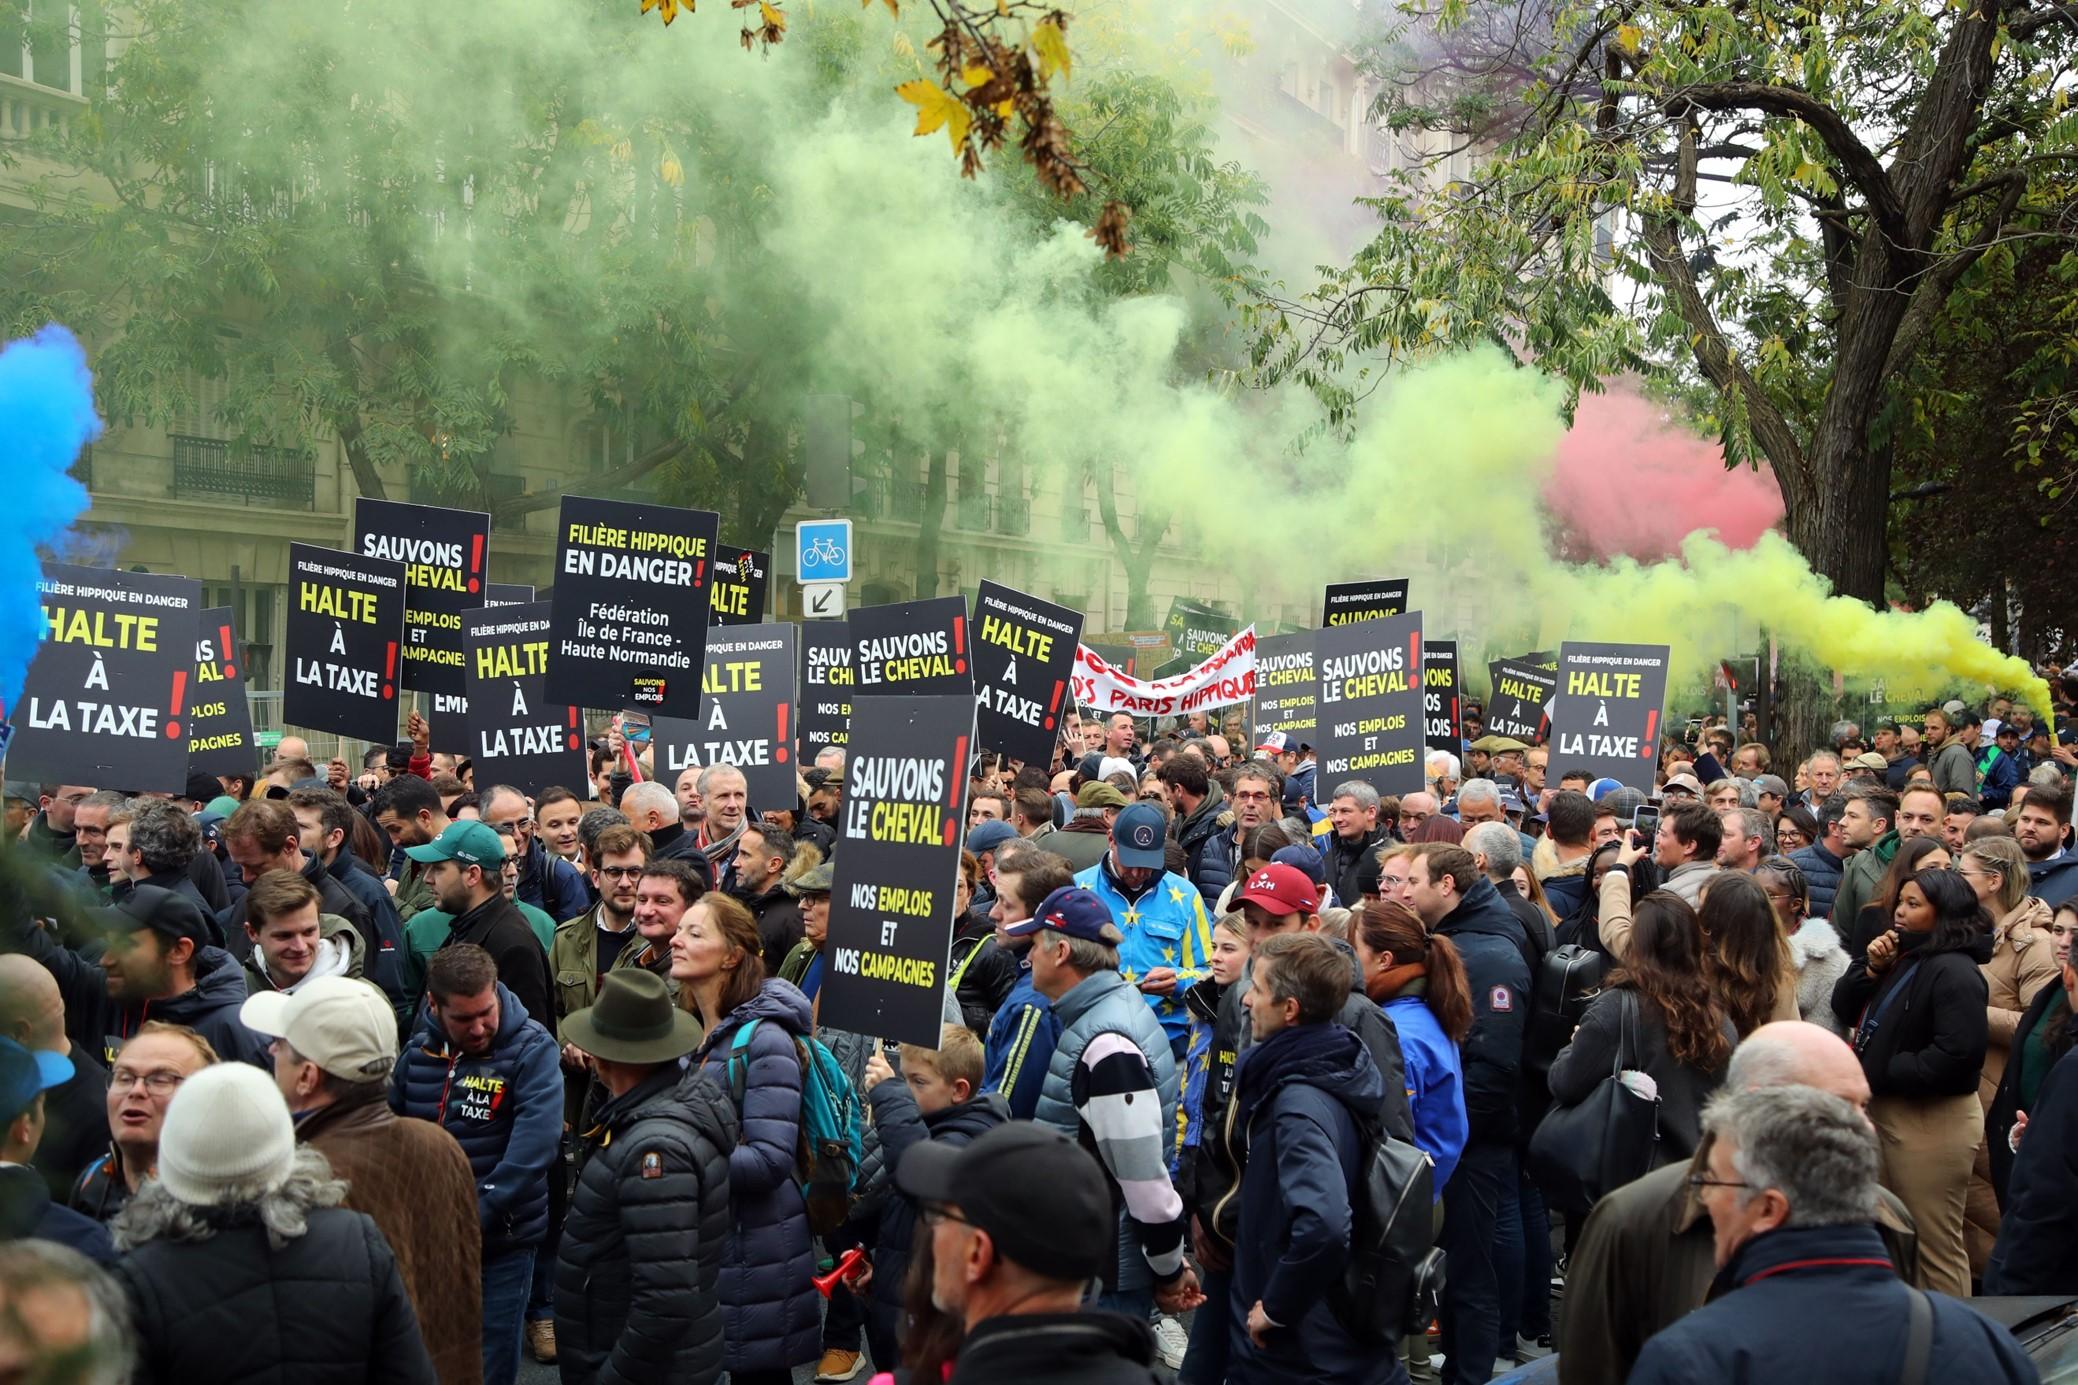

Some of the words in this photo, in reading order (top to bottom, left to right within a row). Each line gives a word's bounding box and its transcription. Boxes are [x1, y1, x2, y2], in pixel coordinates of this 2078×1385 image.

[364, 533, 462, 568] SAUVONS
[569, 522, 627, 548] FILIÈRE
[631, 531, 706, 558] HIPPIQUE
[298, 560, 322, 576] FILIÈRE
[324, 564, 356, 582] HIPPIQUE
[357, 570, 367, 582] EN
[368, 572, 396, 588] DANGER
[564, 549, 594, 575] EN
[406, 564, 466, 592] HEVAL
[36, 580, 75, 596] FILIÈRE
[76, 585, 126, 604] HIPPIQUE
[128, 591, 144, 604] EN
[145, 593, 188, 610] DANGER
[300, 582, 376, 624] HALTE
[710, 581, 749, 616] ALTE
[1350, 594, 1373, 602] HIPPIQUE
[405, 610, 462, 630] EMPLOIS
[590, 602, 669, 626] Fédération
[985, 596, 1007, 614] FILIÈRE
[1007, 602, 1036, 622] HIPPIQUE
[1037, 614, 1047, 625] EN
[1048, 618, 1073, 635] DANGER
[38, 606, 158, 652] HALTE
[330, 622, 346, 655] À
[411, 628, 427, 643] ET
[470, 624, 495, 637] FILIÈRE
[496, 622, 529, 635] HIPPIQUE
[530, 622, 540, 630] EN
[578, 618, 596, 638] Île
[600, 623, 618, 641] de
[622, 626, 672, 647] France
[981, 616, 1053, 663] HALTE
[1187, 628, 1228, 645] SAUVONS
[402, 646, 466, 667] AMPAGNE
[561, 640, 605, 660] Haute
[610, 645, 690, 669] Normandie
[706, 642, 733, 654] PIQUE
[735, 643, 748, 651] EN
[748, 640, 783, 650] DANGER
[808, 647, 850, 666] SAUV
[858, 630, 947, 662] SAUVONS
[1186, 640, 1196, 652] LE
[84, 650, 109, 690] À
[861, 662, 882, 684] LE
[885, 655, 954, 682] CHEVAL
[1002, 655, 1016, 685] À
[1322, 647, 1402, 681] SAUVONS
[1568, 654, 1591, 664] FILIÈRE
[1592, 656, 1622, 666] HIPPIQUE
[1633, 658, 1661, 667] DANGER
[296, 657, 321, 686] LA
[326, 662, 378, 698] TAXE
[634, 677, 666, 686] SAUVONS
[808, 667, 825, 684] LE
[1269, 666, 1316, 686] CHEVAL
[1323, 681, 1341, 703] LE
[1344, 670, 1408, 699] CHEVAL
[1567, 672, 1641, 698] HALTE
[512, 680, 528, 716] À
[635, 694, 663, 702] EMPLOIS
[1110, 688, 1176, 714] PARIS
[1261, 699, 1278, 711] NOS
[1280, 695, 1314, 708] EMPLOIS
[1425, 693, 1441, 712] OS
[1500, 678, 1542, 704] HALTE
[1870, 691, 1882, 704] LE
[28, 696, 71, 732] LA
[77, 702, 158, 739] TAXE
[707, 698, 728, 730] À
[818, 703, 838, 715] NOS
[996, 688, 1042, 727] TAXE
[1284, 710, 1294, 720] ET
[1511, 700, 1520, 718] À
[1593, 699, 1609, 727] À
[1894, 714, 1926, 723] EMPLOIS
[809, 731, 830, 743] NOS
[1255, 723, 1271, 734] NOS
[1273, 718, 1316, 732] CAMPAGNE
[1334, 722, 1356, 738] NOS
[1359, 715, 1405, 733] EMPLOIS
[1425, 718, 1451, 737] LOIS
[1490, 716, 1504, 734] LA
[188, 732, 242, 754] PAGNES
[481, 728, 510, 758] LA
[510, 725, 564, 755] TAXE
[668, 744, 700, 770] LA
[704, 739, 770, 767] TAXE
[1364, 737, 1378, 751] ET
[1560, 733, 1584, 755] LA
[1588, 735, 1638, 758] TAXE
[1326, 759, 1348, 774] NOS
[1350, 749, 1414, 770] CAMPAGNES
[851, 756, 945, 802] SAUVONS
[846, 800, 868, 839] LE
[871, 802, 943, 846] CHEVAL
[851, 883, 877, 910] NOS
[878, 886, 932, 918] EMPLOIS
[881, 921, 898, 947] ET
[834, 948, 859, 975] NOS
[861, 951, 936, 989] CAMPAGNES
[462, 1076, 504, 1093] HALTE
[466, 1089, 474, 1102] À
[476, 1093, 490, 1105] LA
[461, 1104, 491, 1120] TAXE
